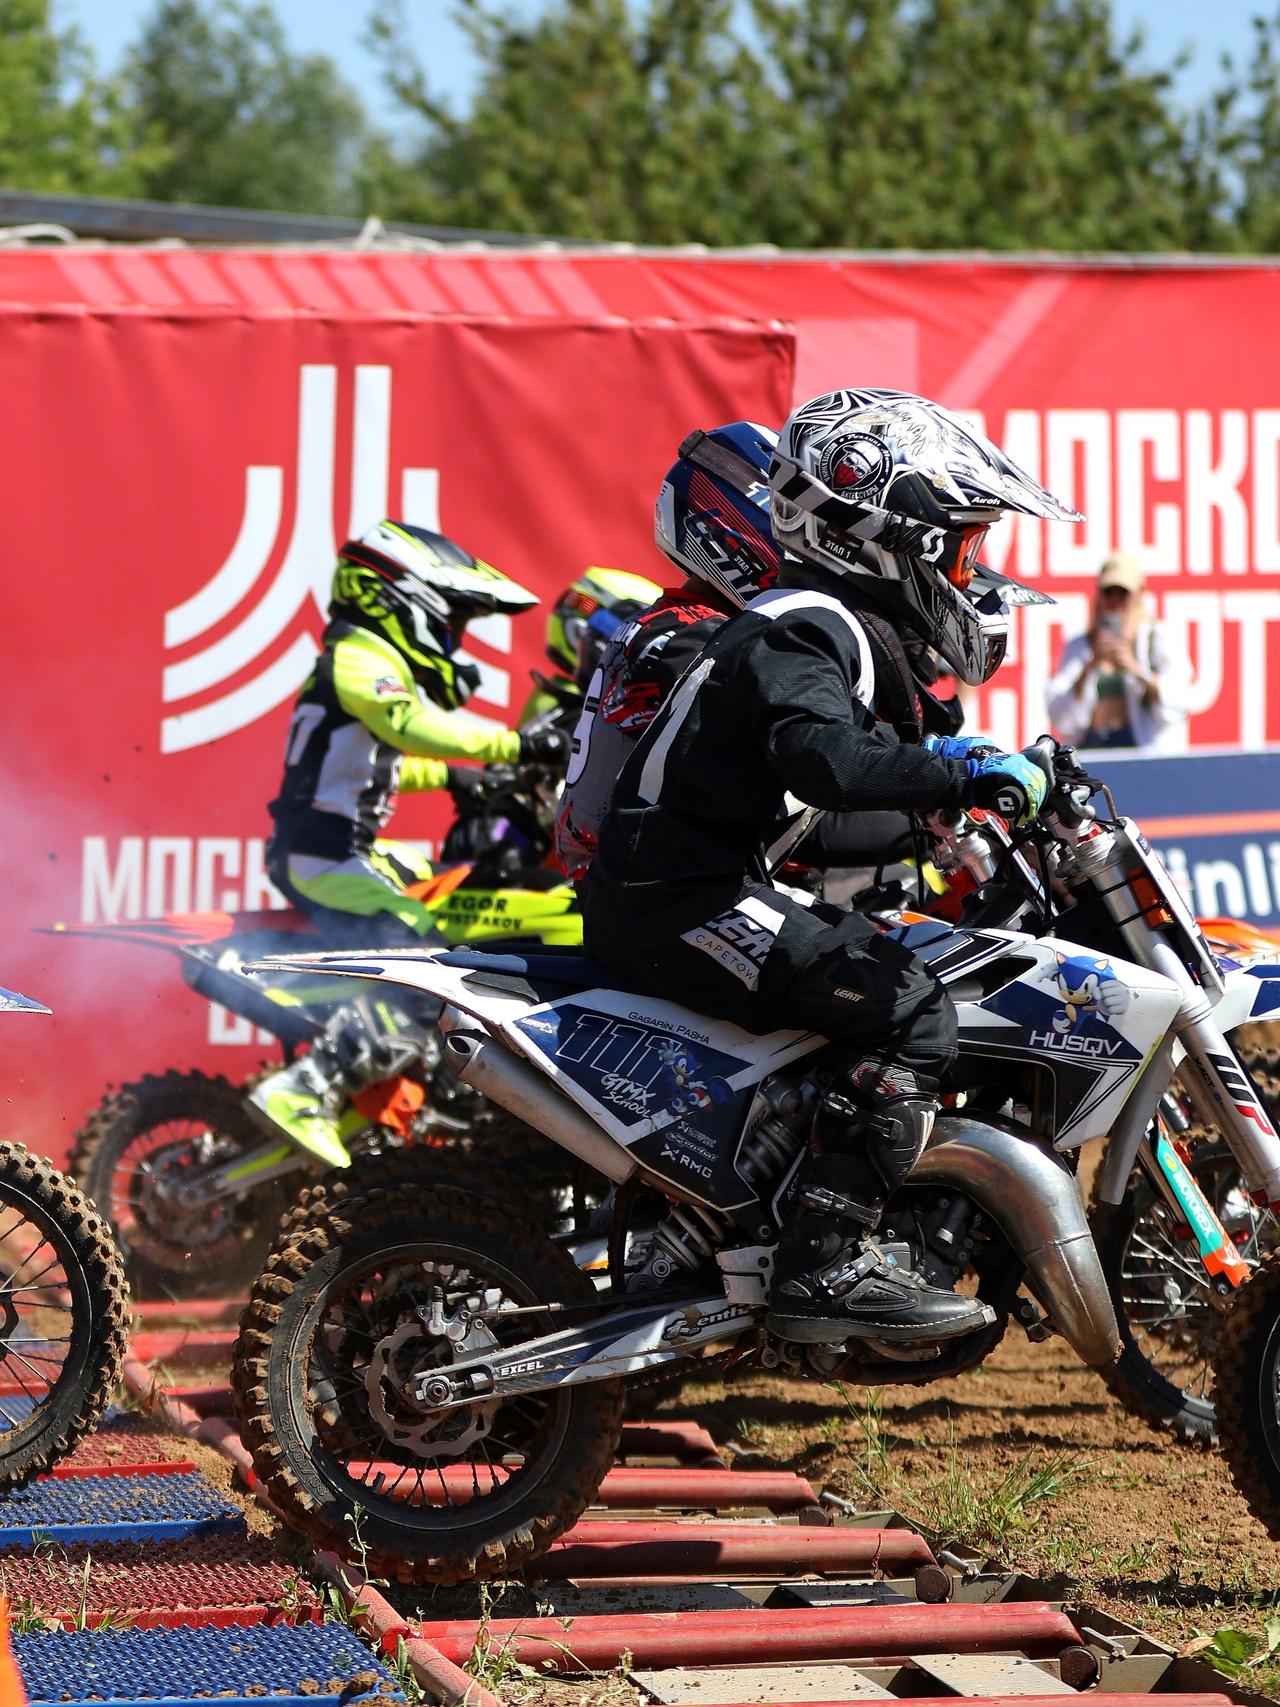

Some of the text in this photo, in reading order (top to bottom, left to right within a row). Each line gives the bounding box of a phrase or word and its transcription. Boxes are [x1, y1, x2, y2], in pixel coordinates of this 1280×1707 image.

[971, 496, 1001, 506] Airoh
[825, 540, 852, 559] ЭТАП 1
[734, 555, 750, 573] ЭТАП
[448, 895, 508, 912] EGOR
[833, 987, 866, 1002] LEATT
[676, 1025, 710, 1045] PASHA
[1028, 1030, 1123, 1058] HUSQV
[555, 1014, 683, 1089] 111
[602, 1092, 652, 1119] SCHOOL
[1172, 1171, 1216, 1238] MOTOREX
[500, 1360, 544, 1376] EXCEL
